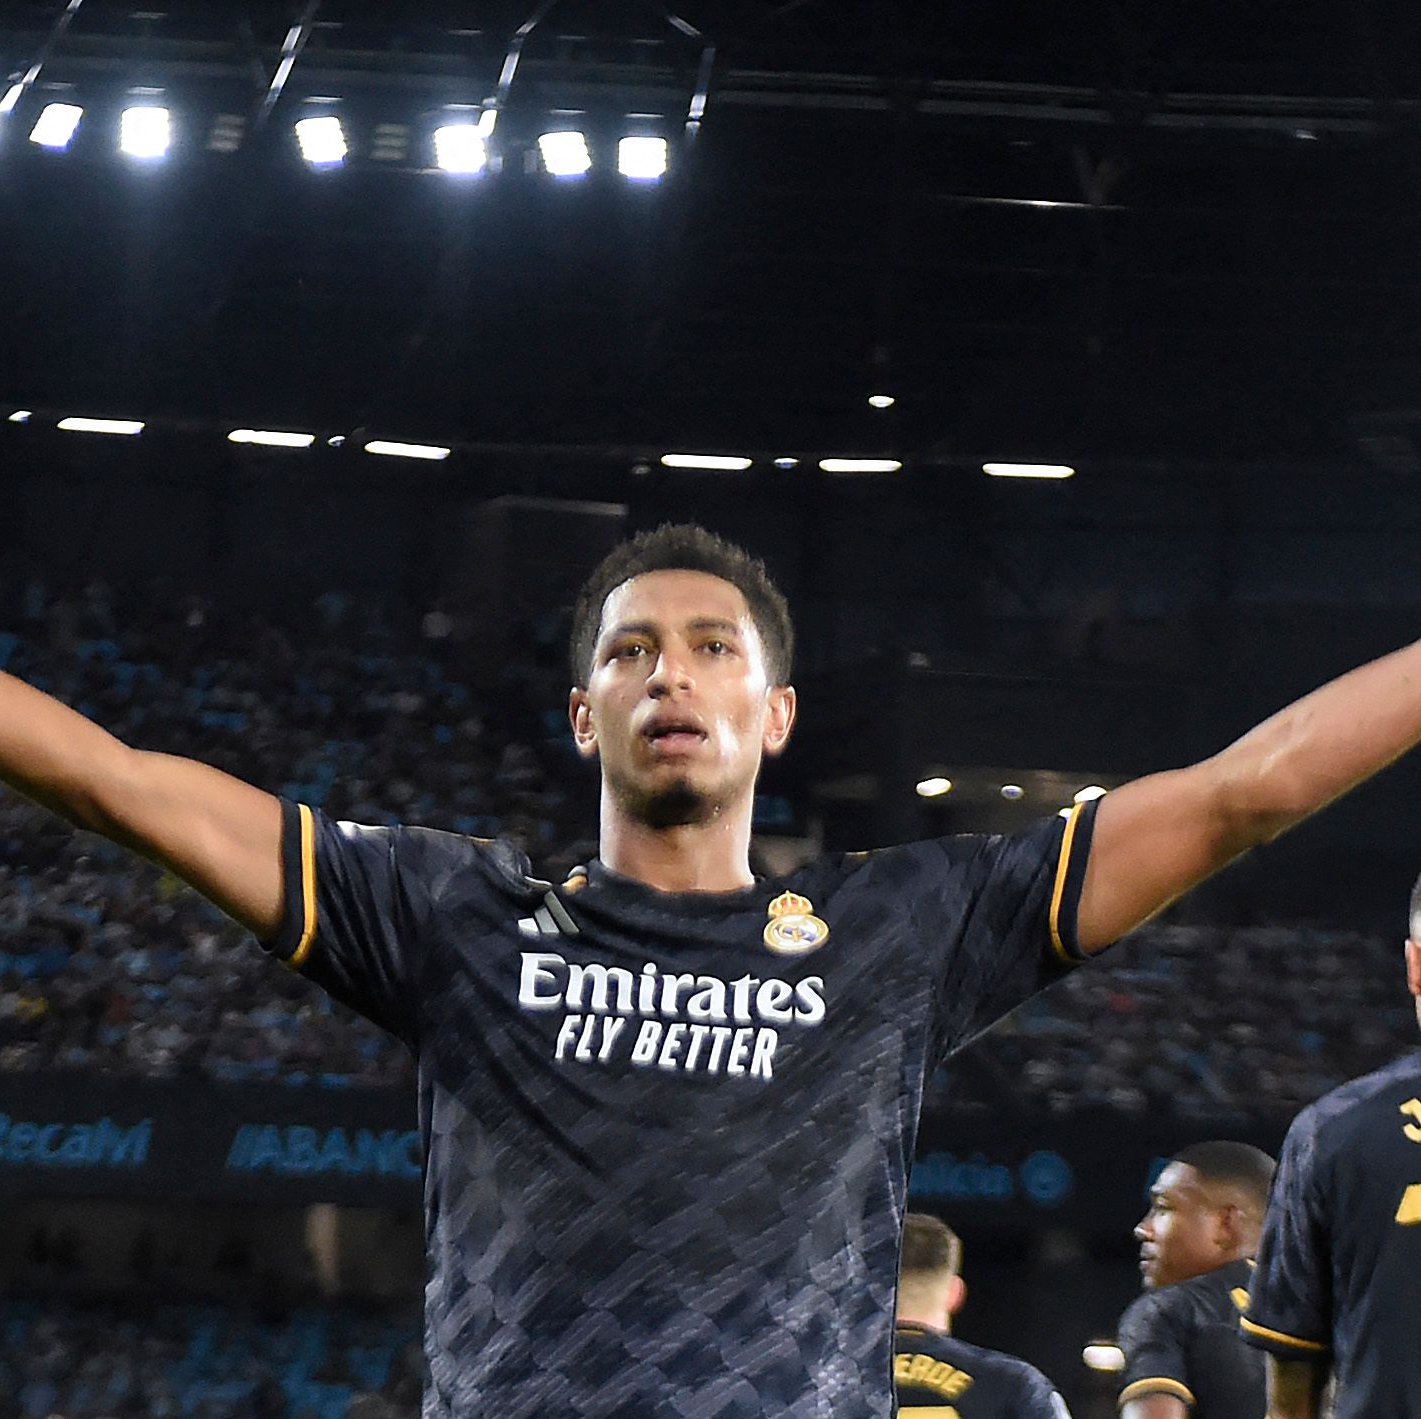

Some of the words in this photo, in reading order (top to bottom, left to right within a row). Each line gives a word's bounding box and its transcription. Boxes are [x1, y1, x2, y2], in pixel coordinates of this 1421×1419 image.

[518, 951, 828, 1026] Emirates
[554, 1014, 625, 1062] FLY
[631, 1017, 779, 1081] BETTER
[246, 1122, 424, 1177] ABANC
[894, 1353, 974, 1399] ERDE
